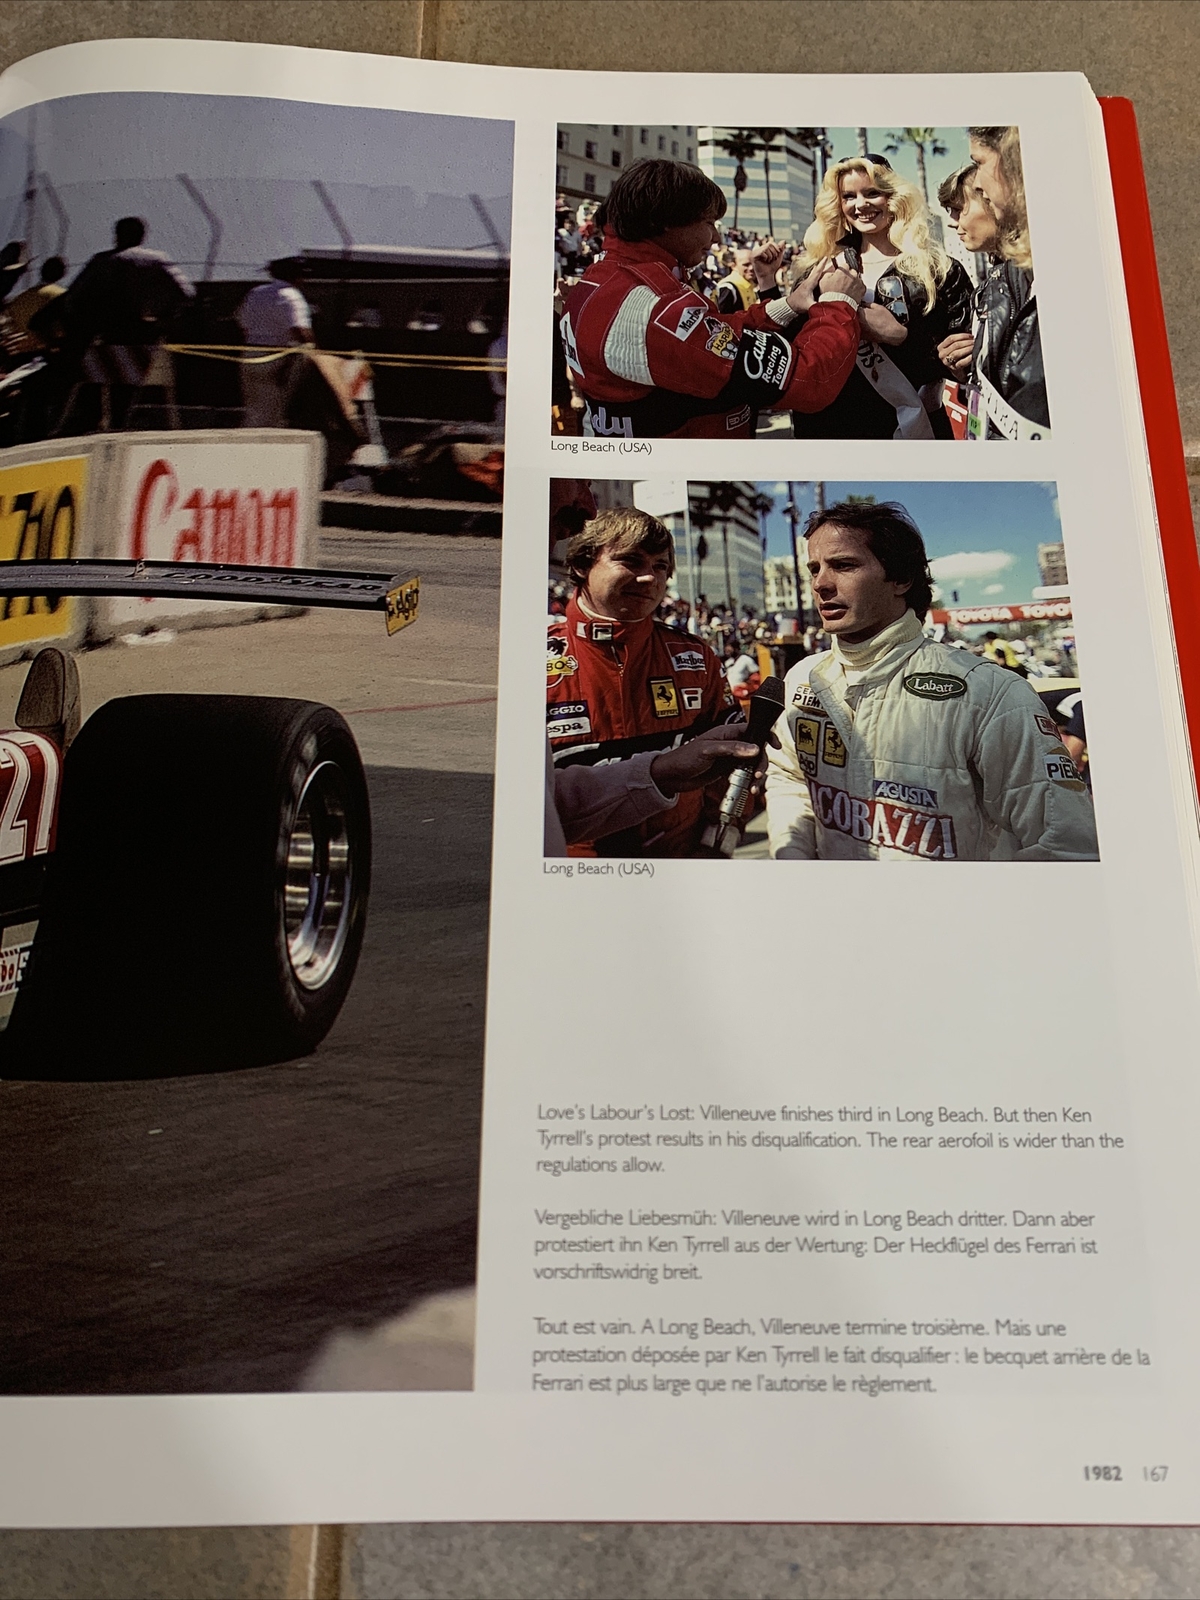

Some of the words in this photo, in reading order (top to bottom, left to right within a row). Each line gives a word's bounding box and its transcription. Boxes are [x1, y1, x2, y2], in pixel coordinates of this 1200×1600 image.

[761, 345, 782, 384] Racing
[771, 354, 788, 386] Team
[551, 440, 578, 454] Long
[582, 440, 616, 453] Beach
[619, 441, 652, 456] (USA)
[1019, 602, 1071, 620] TOYO
[914, 678, 953, 693] Labatt
[792, 693, 823, 709] PIEM
[875, 781, 936, 808] AGUSTA
[544, 862, 573, 877] Long
[577, 862, 615, 877] Beach
[618, 862, 654, 877] (USA)
[538, 1104, 585, 1120] Love's
[591, 1103, 654, 1120] Labour's
[660, 1104, 694, 1121] Lost:
[699, 1104, 776, 1121] Villeneuve
[780, 1105, 834, 1121] finishes
[838, 1106, 872, 1122] third
[878, 1106, 891, 1121] in
[896, 1106, 934, 1127] Long
[938, 1106, 988, 1122] Beach.
[993, 1107, 1019, 1123] But
[1023, 1107, 1057, 1122] then
[1062, 1107, 1092, 1123] Ken
[537, 1129, 593, 1150] Tyrrell's
[598, 1131, 652, 1150] protest
[656, 1130, 704, 1147] results
[709, 1131, 722, 1146] in
[727, 1131, 747, 1147] his
[751, 1130, 861, 1151] disqualification.
[866, 1131, 898, 1148] The
[903, 1136, 933, 1148] rear
[938, 1132, 993, 1148] aerofoil
[998, 1132, 1009, 1148] is
[1013, 1132, 1057, 1148] wider
[1061, 1132, 1094, 1148] than
[1099, 1133, 1124, 1148] the
[536, 1156, 617, 1177] regulations
[622, 1156, 665, 1172] allow.
[534, 1209, 623, 1230] Vergebliche
[629, 1209, 716, 1226] Liebesmüh:
[721, 1210, 800, 1226] Villeneuve
[805, 1210, 839, 1226] wird
[845, 1210, 858, 1226] in
[863, 1210, 902, 1231] Long
[907, 1210, 953, 1226] Beach
[958, 1210, 1007, 1226] dritter.
[1013, 1210, 1056, 1227] Dann
[1060, 1211, 1095, 1227] aber
[534, 1236, 615, 1256] protestiert
[619, 1236, 642, 1252] ihn
[648, 1236, 678, 1252] Ken
[682, 1236, 729, 1257] Tyrrell
[734, 1241, 760, 1253] aus
[764, 1237, 792, 1253] der
[874, 1236, 905, 1253] Der
[910, 1237, 989, 1258] Heckflügel
[994, 1237, 1021, 1253] des
[1026, 1237, 1076, 1254] Ferrari
[1080, 1237, 1098, 1254] ist
[533, 1262, 659, 1283] vorschriftswidrig
[663, 1263, 702, 1280] breit.
[533, 1317, 569, 1335] Tout
[573, 1321, 596, 1335] est
[600, 1318, 636, 1335] vain.
[641, 1318, 655, 1334] A
[659, 1319, 699, 1340] Long
[760, 1318, 841, 1335] Villeneuve
[845, 1318, 907, 1335] termine
[911, 1318, 989, 1336] troisième.
[995, 1319, 1031, 1336] Mais
[1036, 1324, 1066, 1336] une
[532, 1346, 626, 1367] protestation
[631, 1345, 700, 1367] déposée
[705, 1351, 731, 1367] par
[736, 1346, 767, 1363] Ken
[771, 1345, 820, 1367] Tyrrell
[825, 1346, 839, 1363] le
[843, 1346, 866, 1363] fait
[871, 1346, 951, 1368] disqualifier
[964, 1347, 979, 1364] le
[983, 1347, 1049, 1369] becquet
[1053, 1348, 1106, 1365] arrière
[1111, 1348, 1132, 1365] de
[1137, 1349, 1151, 1365] la
[532, 1373, 583, 1391] Ferrari
[588, 1377, 612, 1391] est
[616, 1374, 648, 1396] plus
[653, 1375, 691, 1396] large
[695, 1379, 727, 1396] que
[731, 1379, 752, 1392] ne
[757, 1374, 827, 1392] l'autorise
[832, 1374, 847, 1392] le
[852, 1375, 937, 1397] règlement.
[1084, 1465, 1123, 1481] 1982
[1143, 1465, 1169, 1482] 167
